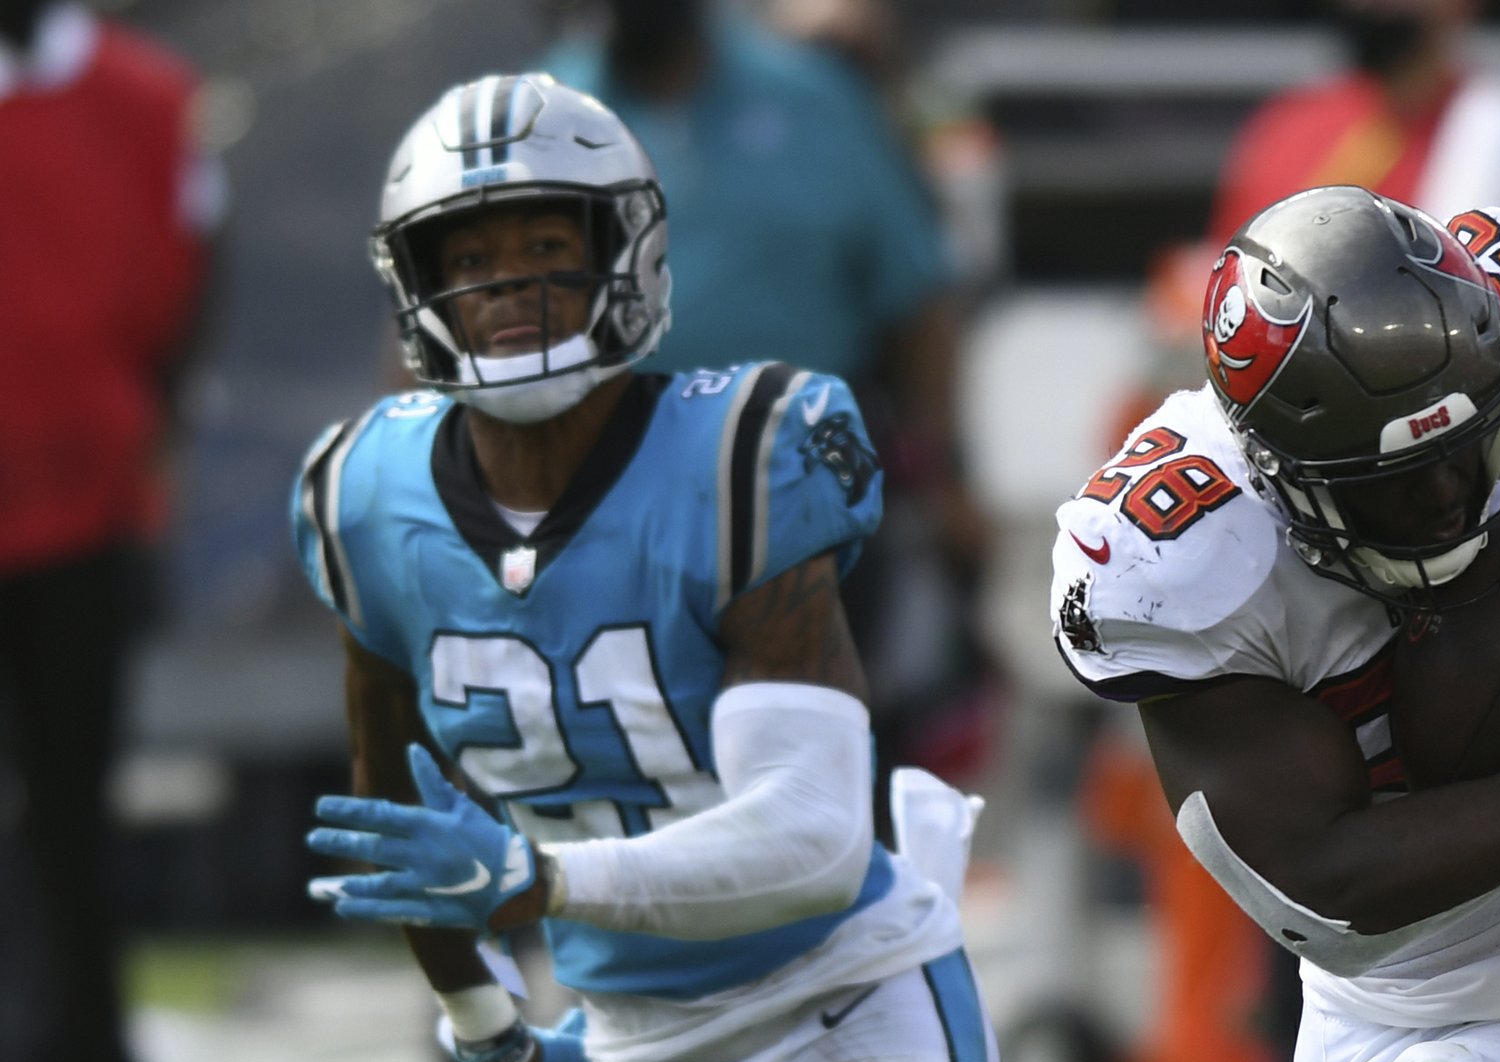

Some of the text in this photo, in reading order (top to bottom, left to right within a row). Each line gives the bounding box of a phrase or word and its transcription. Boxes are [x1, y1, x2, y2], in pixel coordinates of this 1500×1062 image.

[1408, 405, 1451, 439] BUCS
[1073, 426, 1243, 542] 28
[430, 620, 730, 843] 21
